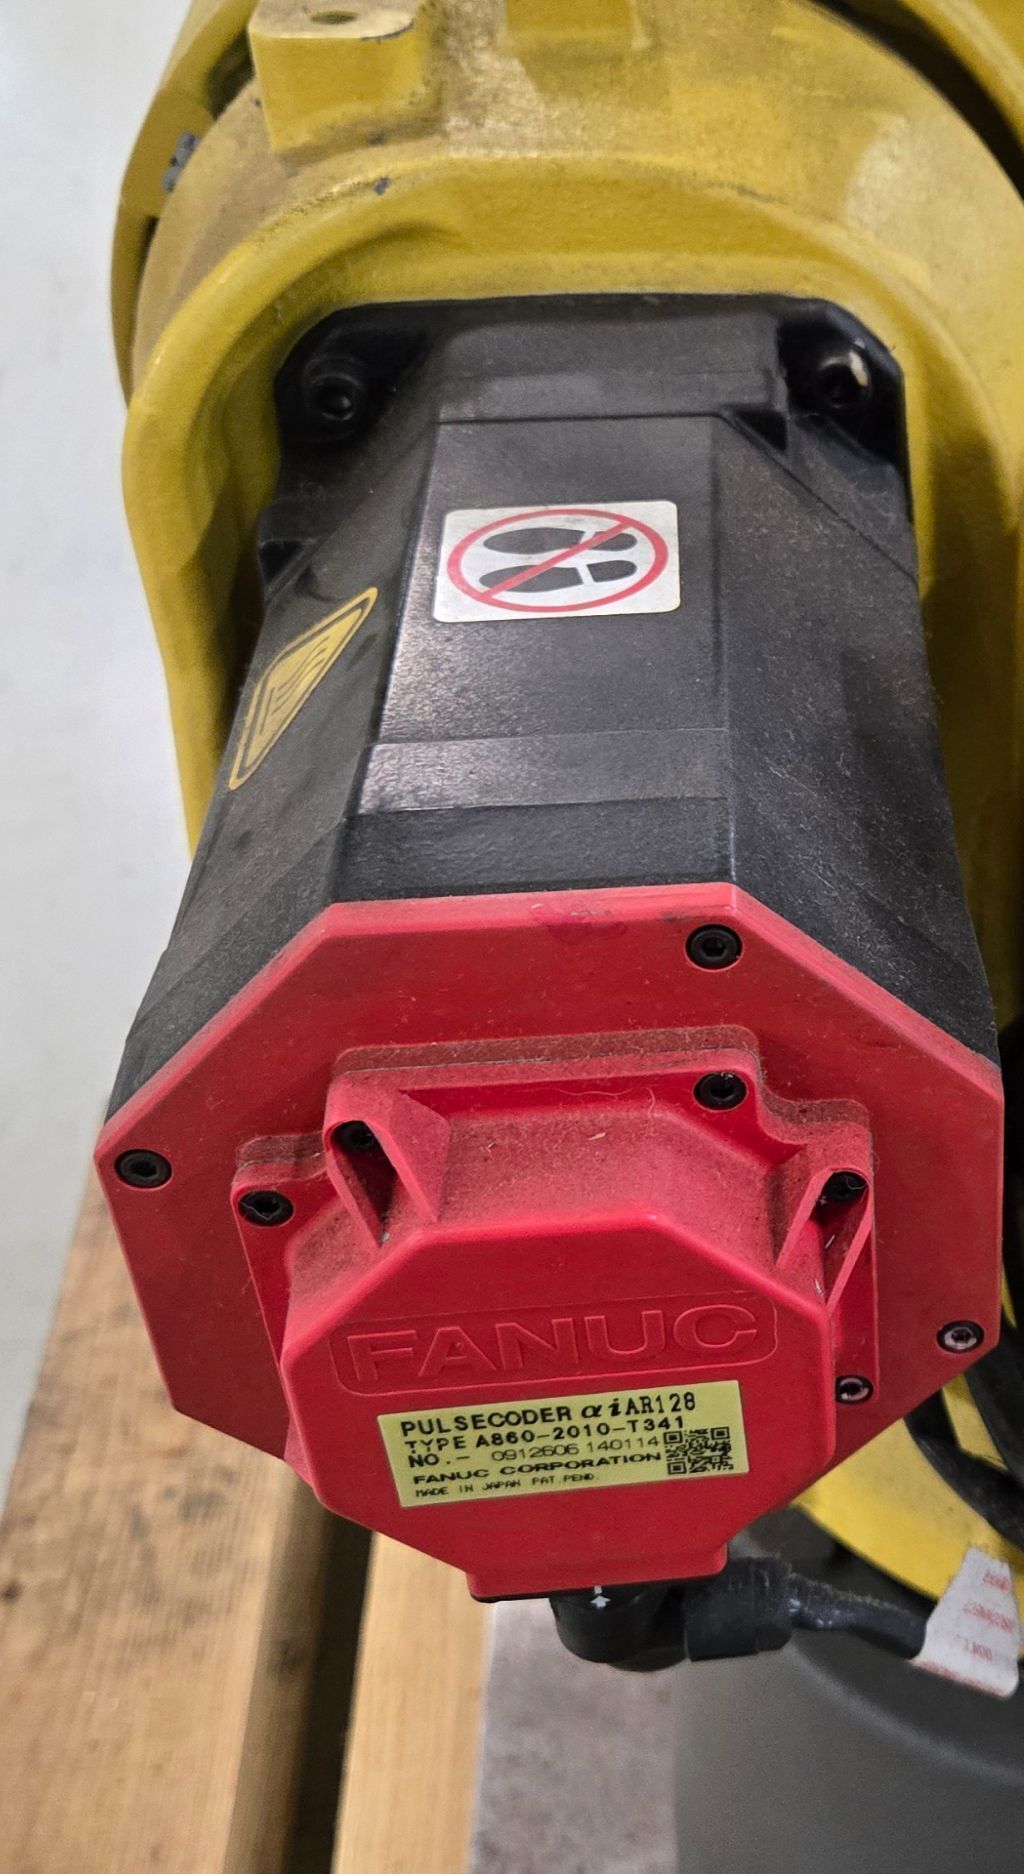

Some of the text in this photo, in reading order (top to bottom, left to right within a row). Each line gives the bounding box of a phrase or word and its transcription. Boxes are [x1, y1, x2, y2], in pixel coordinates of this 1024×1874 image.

[346, 1304, 759, 1384] FANUC
[401, 1406, 572, 1437] PULSECODER
[405, 1416, 684, 1454] TYPE A860-2010-T341
[413, 1453, 662, 1484] FANUC CORPORATION
[416, 1486, 449, 1498] MADE
[459, 1484, 474, 1493] IN
[482, 1479, 521, 1491] JAPAN
